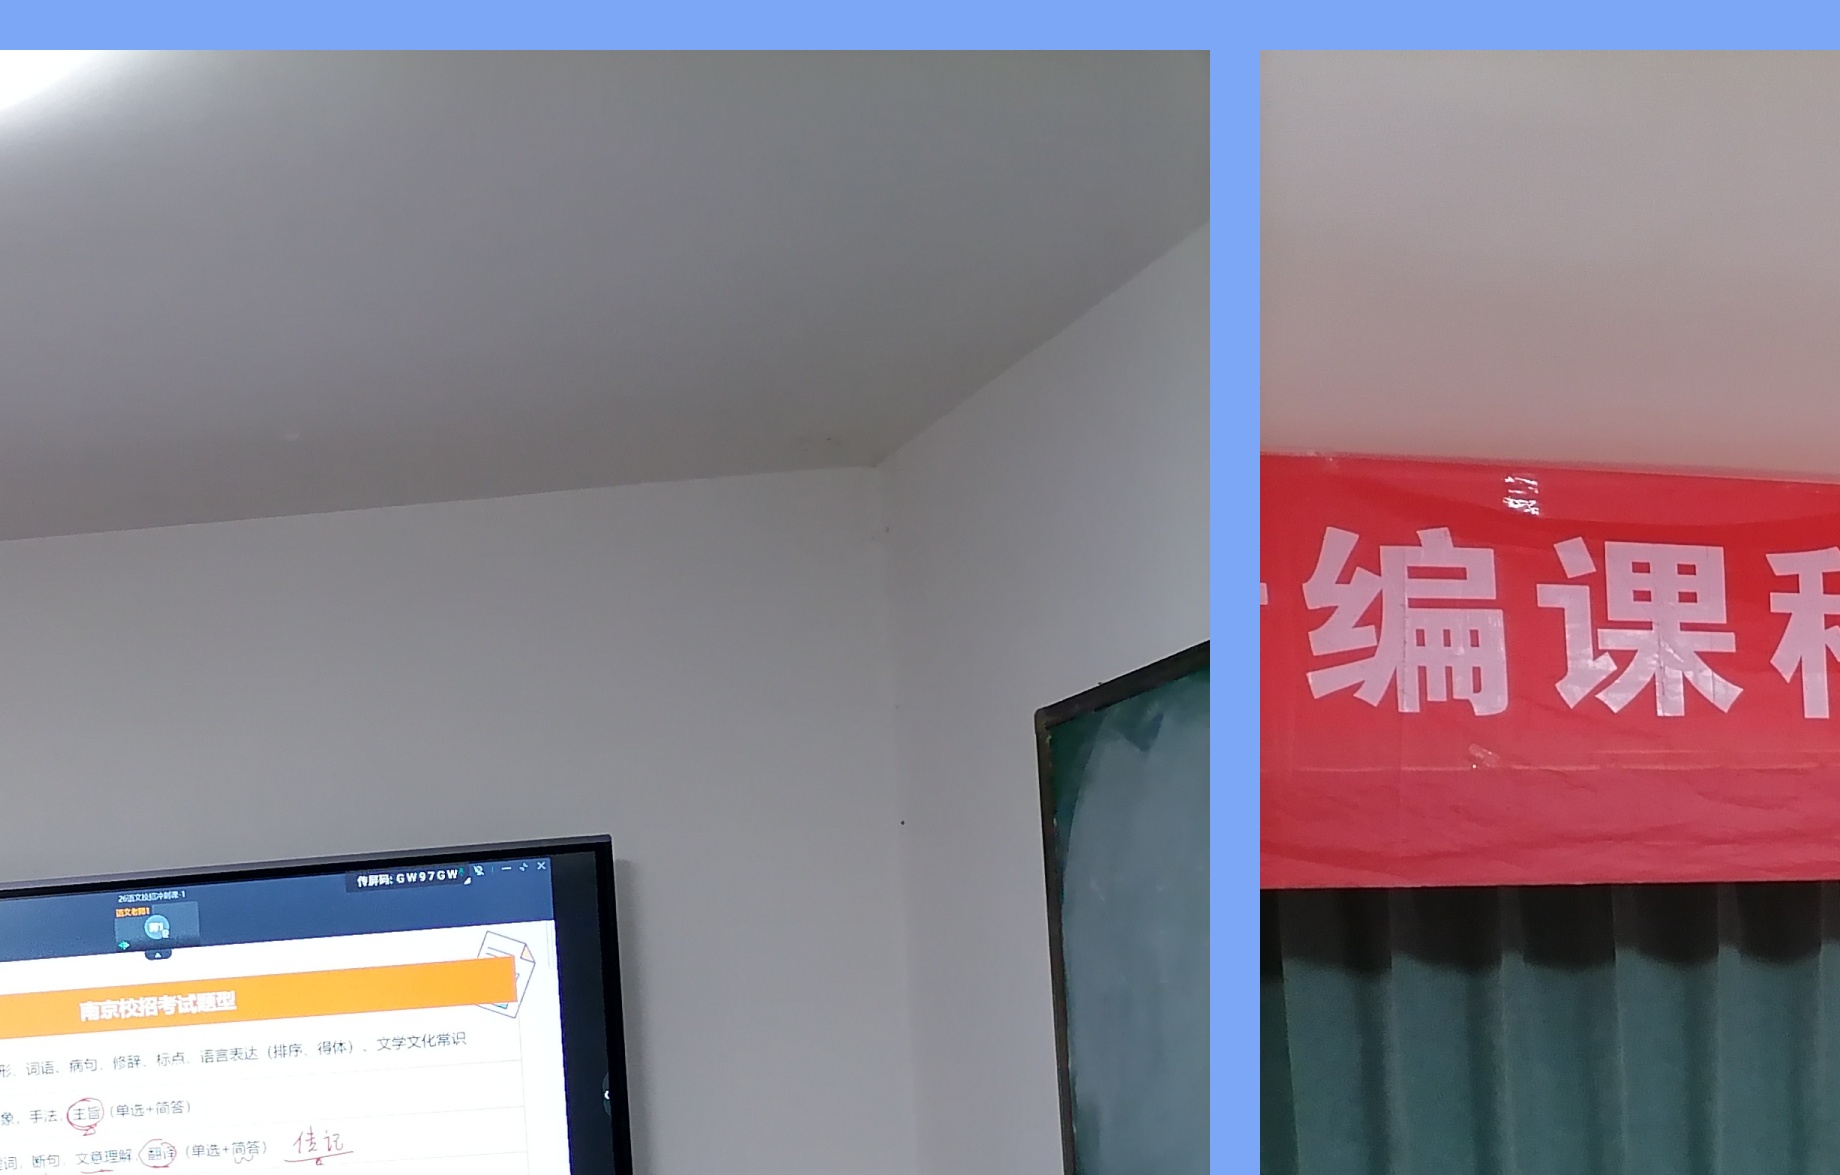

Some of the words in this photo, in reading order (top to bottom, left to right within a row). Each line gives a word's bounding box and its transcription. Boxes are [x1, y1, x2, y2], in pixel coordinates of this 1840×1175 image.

[79, 990, 238, 1022] 南京校招考试题型
